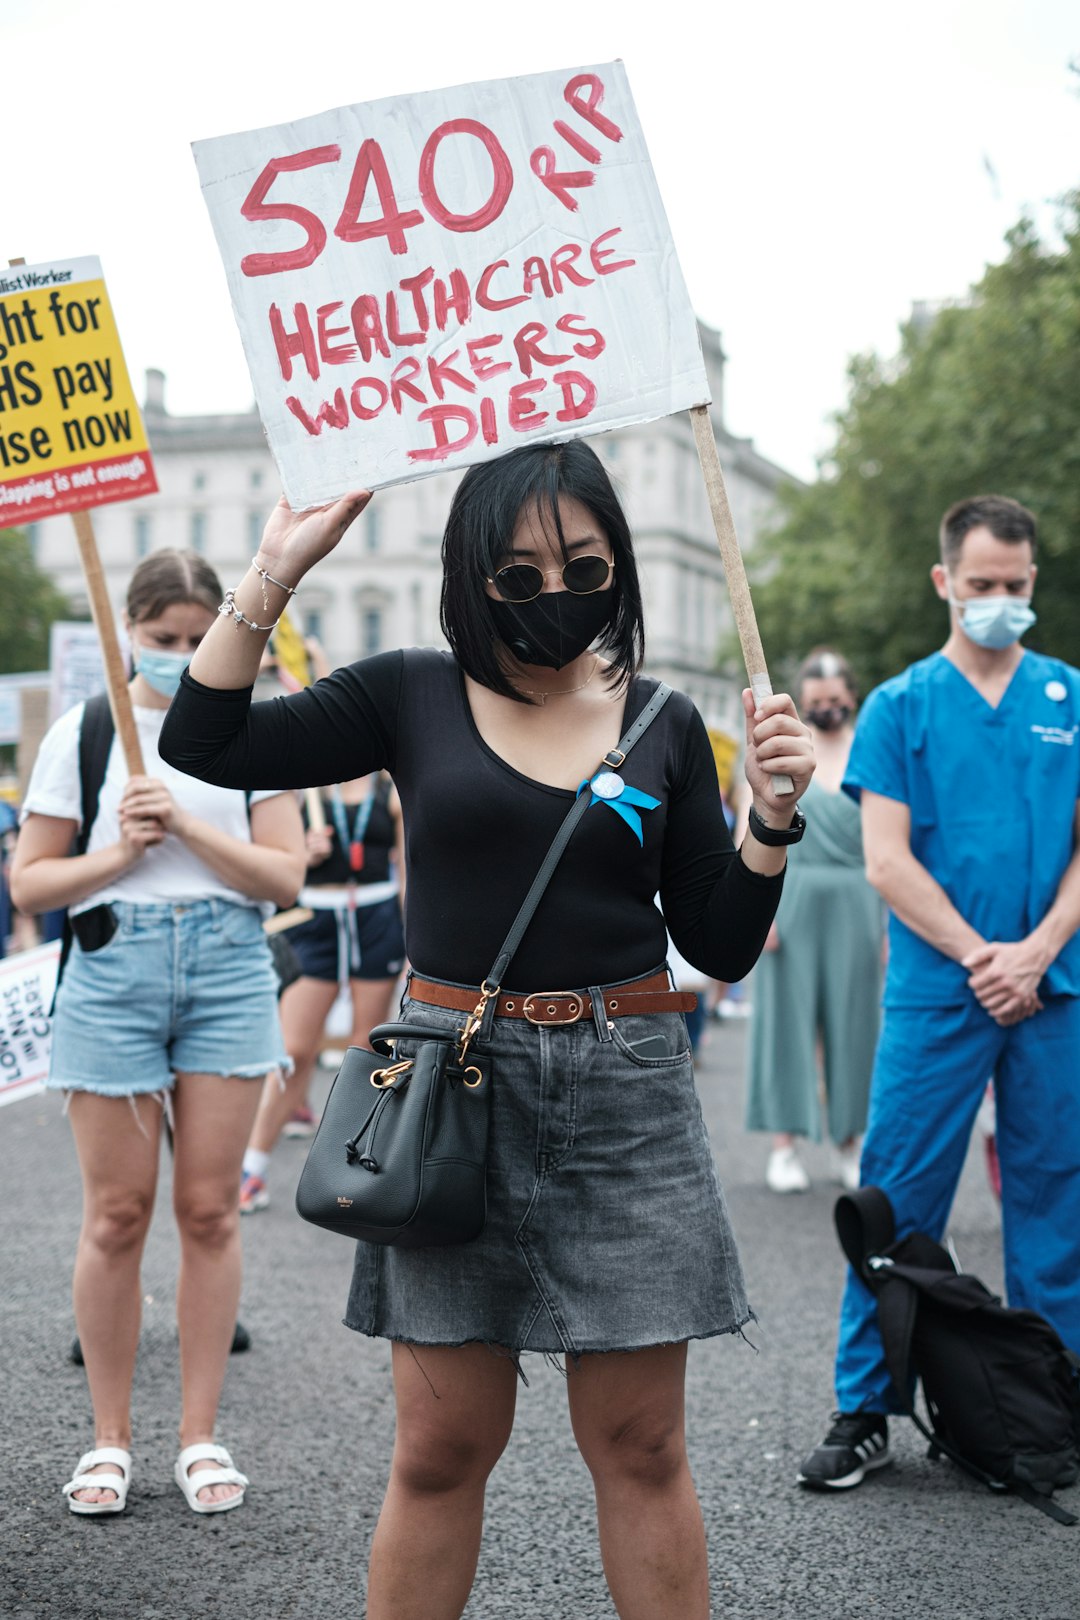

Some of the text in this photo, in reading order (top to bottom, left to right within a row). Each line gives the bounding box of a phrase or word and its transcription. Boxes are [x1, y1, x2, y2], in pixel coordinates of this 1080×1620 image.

[530, 73, 623, 212] RIP
[240, 117, 513, 277] 540
[0, 269, 73, 294] list Worker
[48, 291, 102, 337] for
[269, 227, 636, 382] HEALTHCARE
[53, 357, 115, 410] pay
[286, 313, 606, 436] WORKERS
[0, 408, 133, 468] ise now
[407, 370, 597, 462] DIED
[53, 472, 70, 493] is
[71, 465, 97, 489] not
[96, 455, 147, 483] enough
